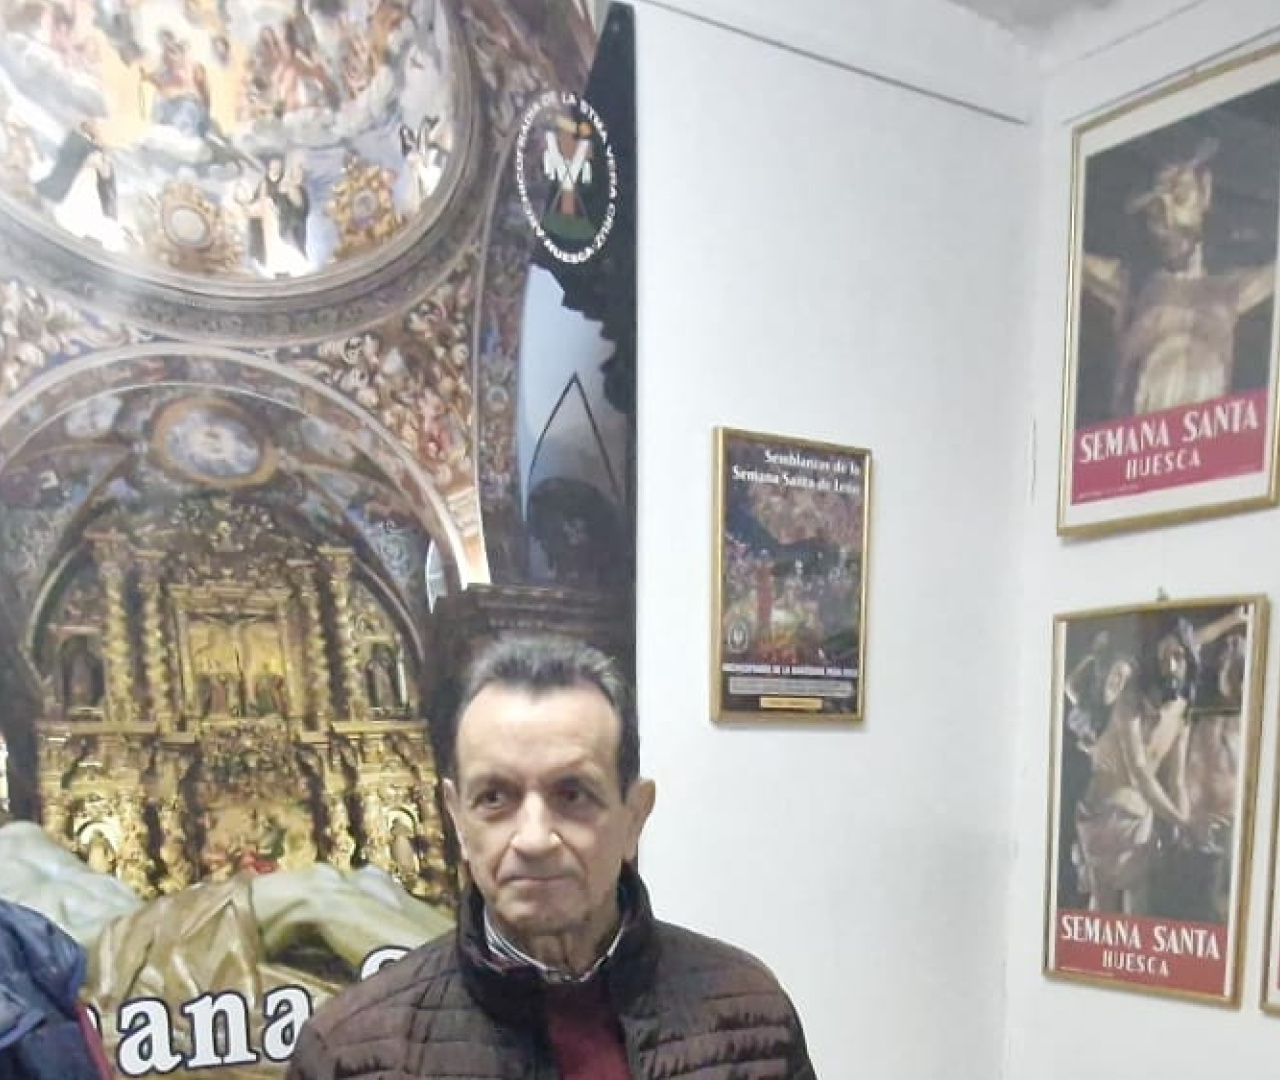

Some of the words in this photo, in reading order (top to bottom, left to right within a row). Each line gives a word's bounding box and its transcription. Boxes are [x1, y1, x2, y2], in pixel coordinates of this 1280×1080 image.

[1080, 419, 1168, 463] SEMANA
[1181, 399, 1258, 442] SANTA
[732, 464, 778, 484] Semana
[1125, 448, 1201, 480] HUESCA
[1060, 915, 1141, 949] SEMANA
[1152, 925, 1220, 960] SANTA
[1103, 950, 1168, 977] HUESCA
[92, 986, 312, 1075] ana
